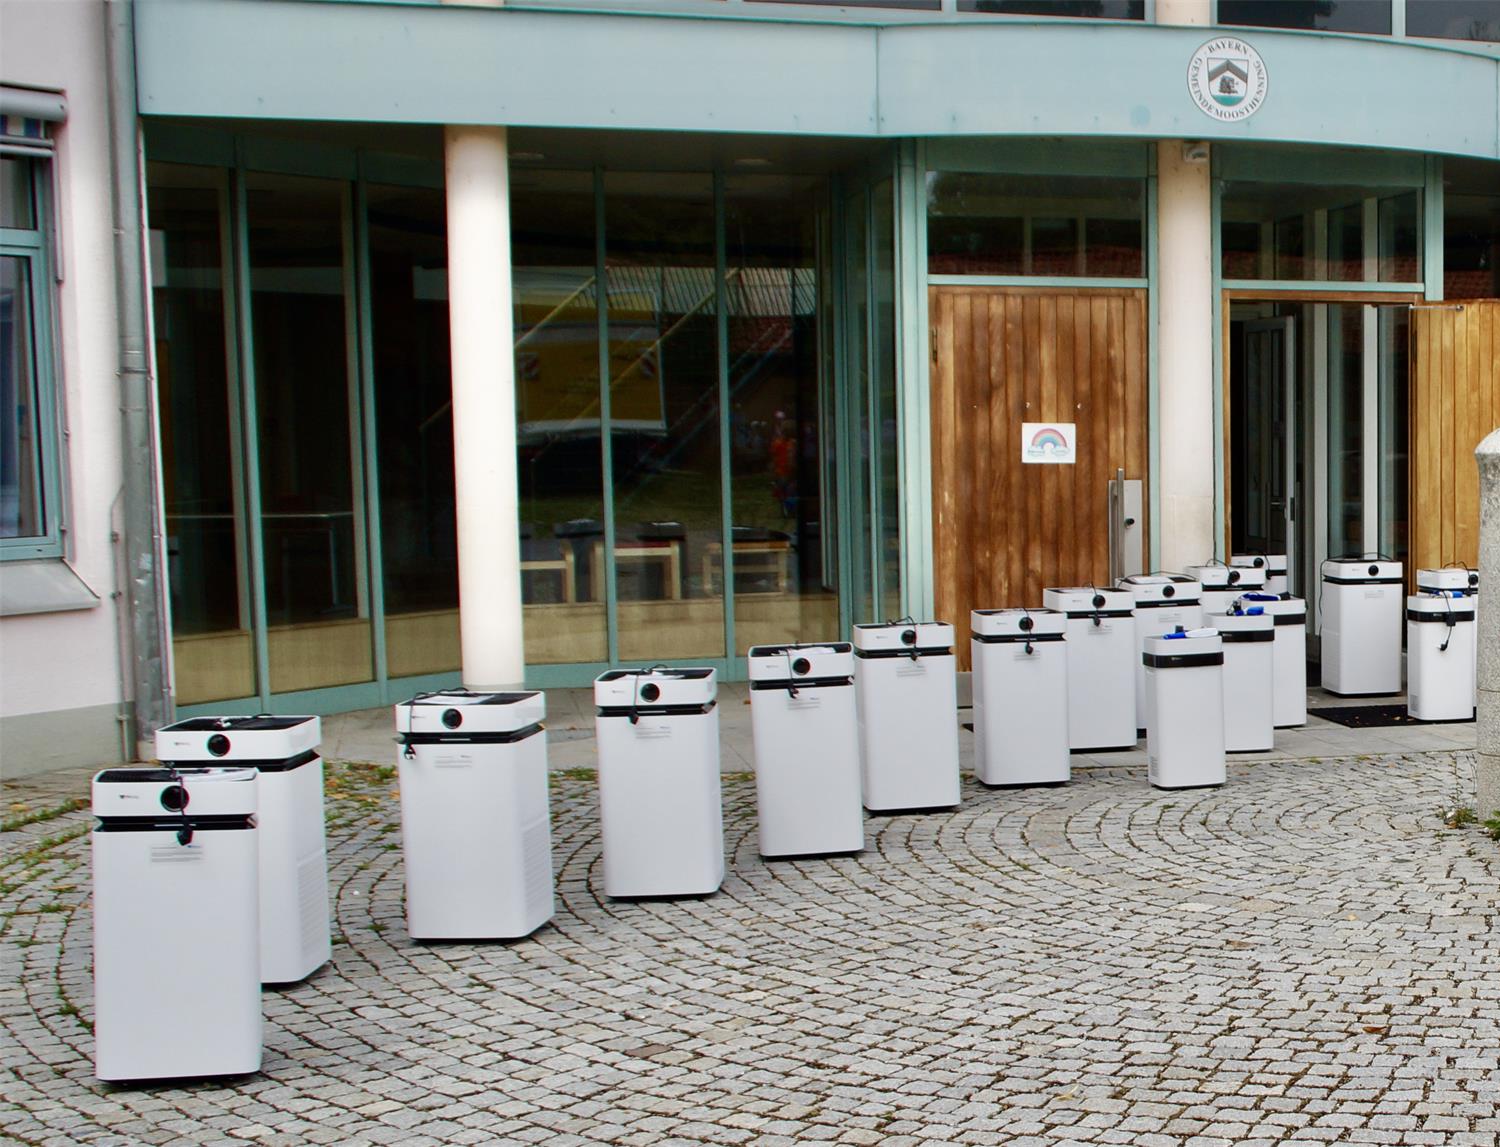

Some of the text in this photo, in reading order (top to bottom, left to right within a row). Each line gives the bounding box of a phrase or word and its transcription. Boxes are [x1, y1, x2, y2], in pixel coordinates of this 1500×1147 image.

[1207, 40, 1248, 54] BAYERN
[1191, 57, 1264, 119] GEMEINDE MOOSTHENNING
